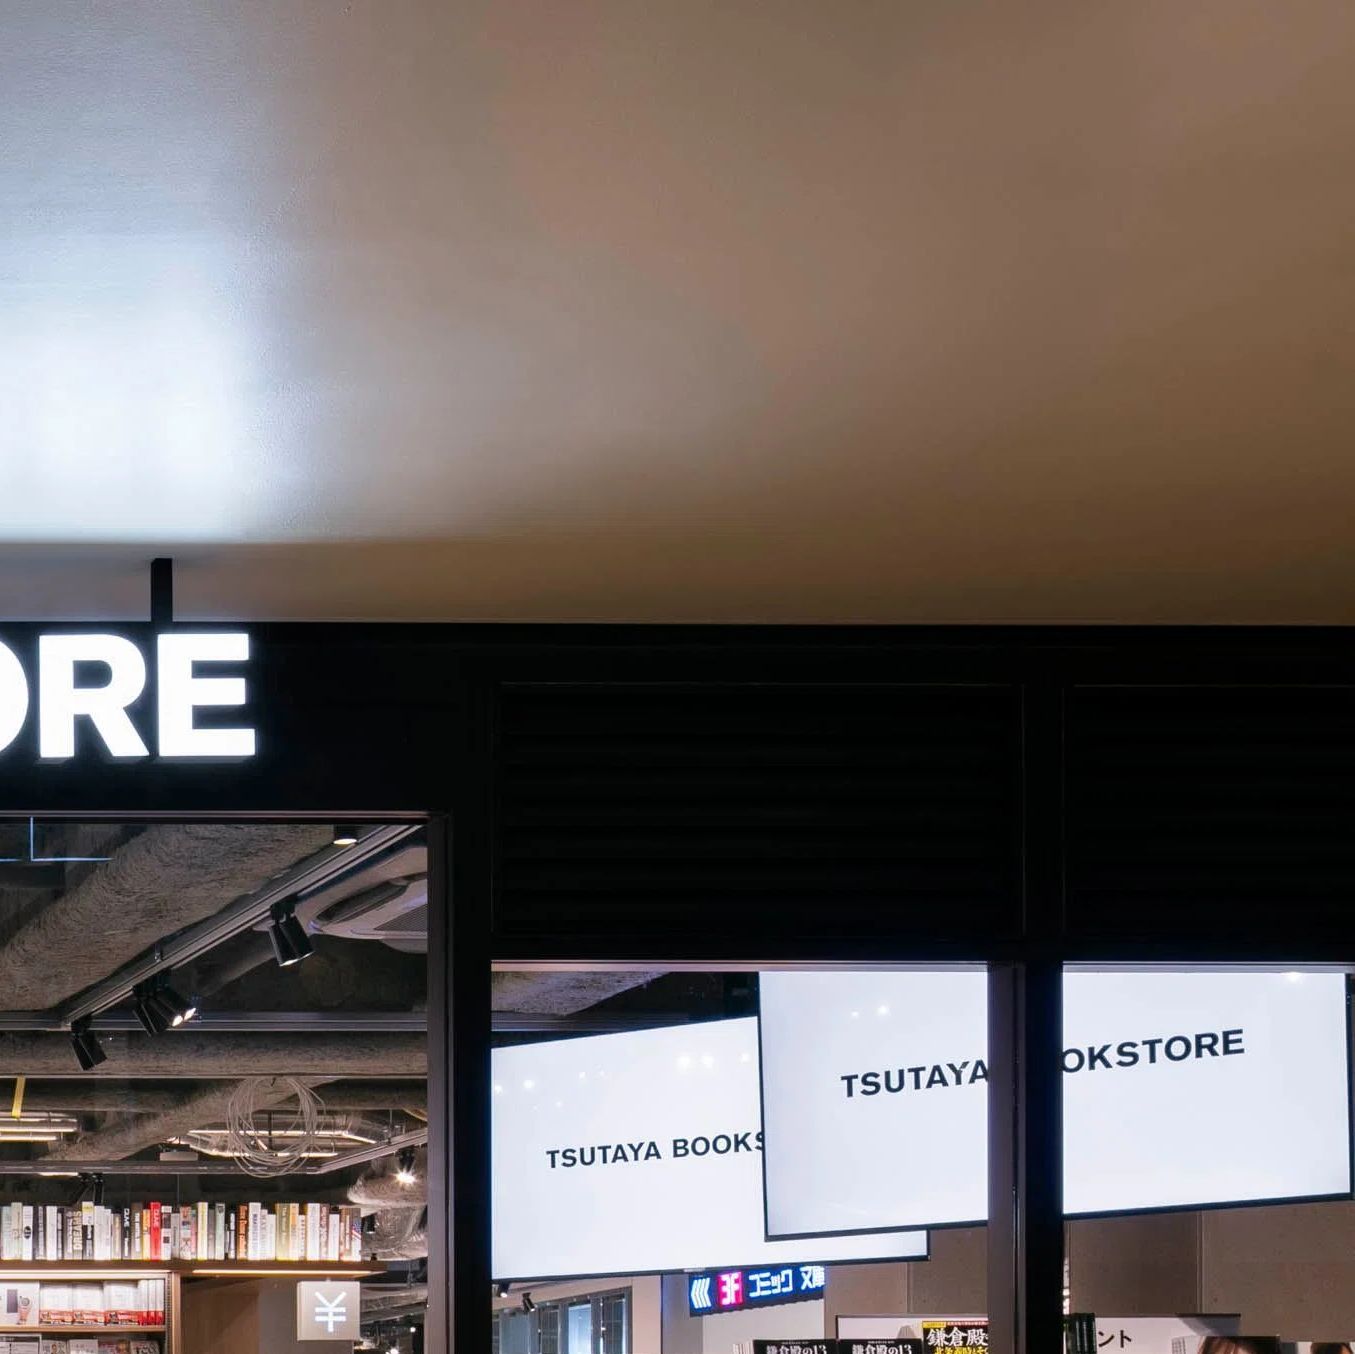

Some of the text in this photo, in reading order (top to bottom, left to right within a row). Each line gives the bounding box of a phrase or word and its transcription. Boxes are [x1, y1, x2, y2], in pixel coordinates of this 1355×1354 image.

[841, 1029, 1246, 1099] TSUTAYA OKSTORE
[546, 1141, 662, 1169] TSUTAYA
[72, 1210, 82, 1250] DREAMS
[719, 1271, 742, 1306] 3F
[748, 1269, 793, 1298] コミック
[926, 1327, 988, 1347] 鎌倉殿
[1098, 1328, 1132, 1348] ント
